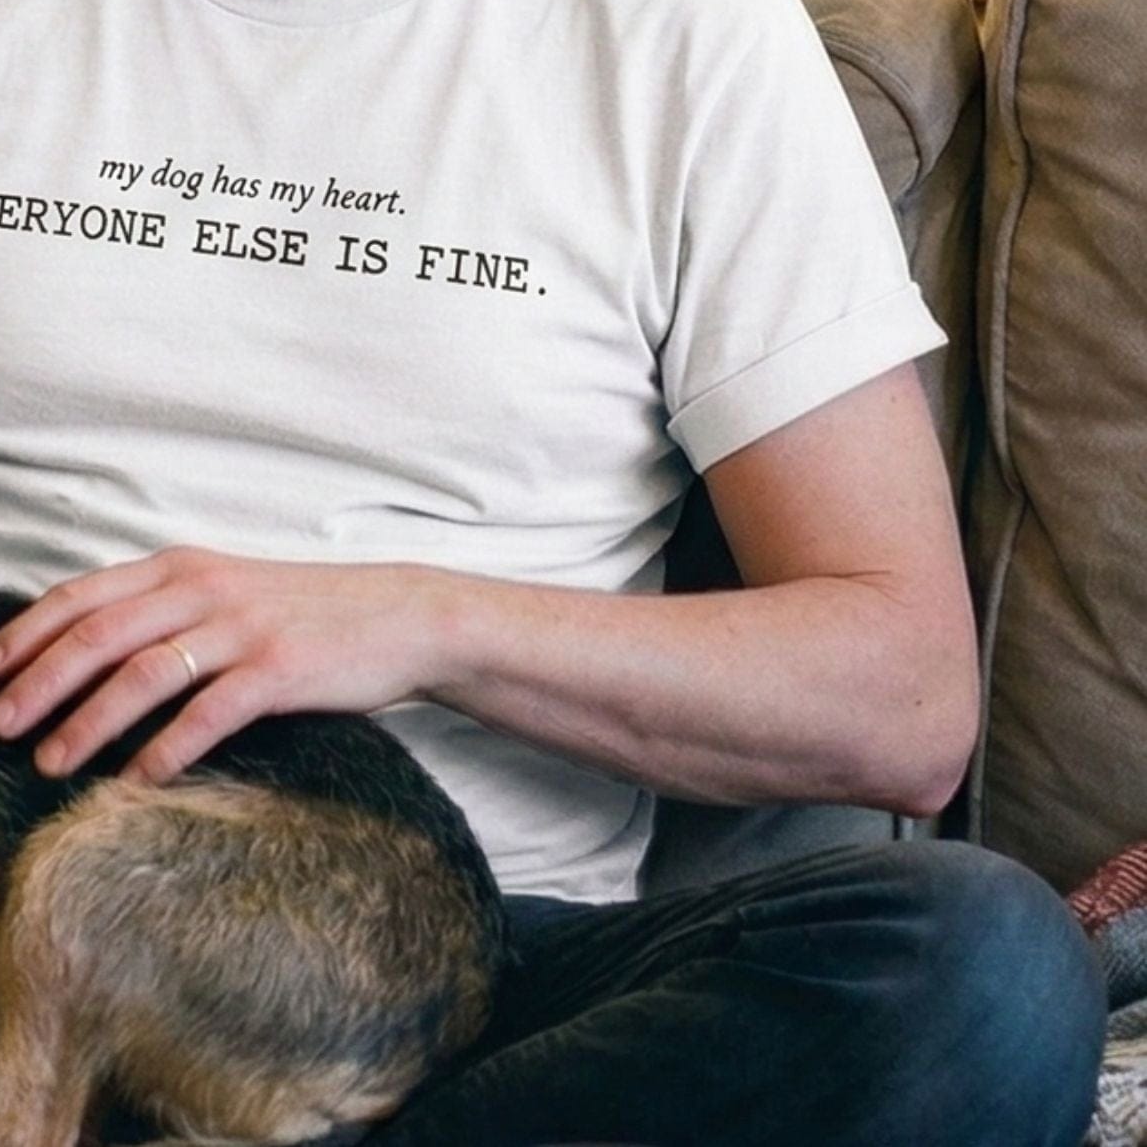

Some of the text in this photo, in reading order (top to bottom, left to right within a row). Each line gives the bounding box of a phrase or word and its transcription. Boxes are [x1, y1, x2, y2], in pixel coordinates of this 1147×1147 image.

[98, 157, 407, 216] my dog has my heart.
[191, 218, 309, 267] ELSE
[334, 234, 389, 276] IS
[414, 244, 548, 297] FINE.
